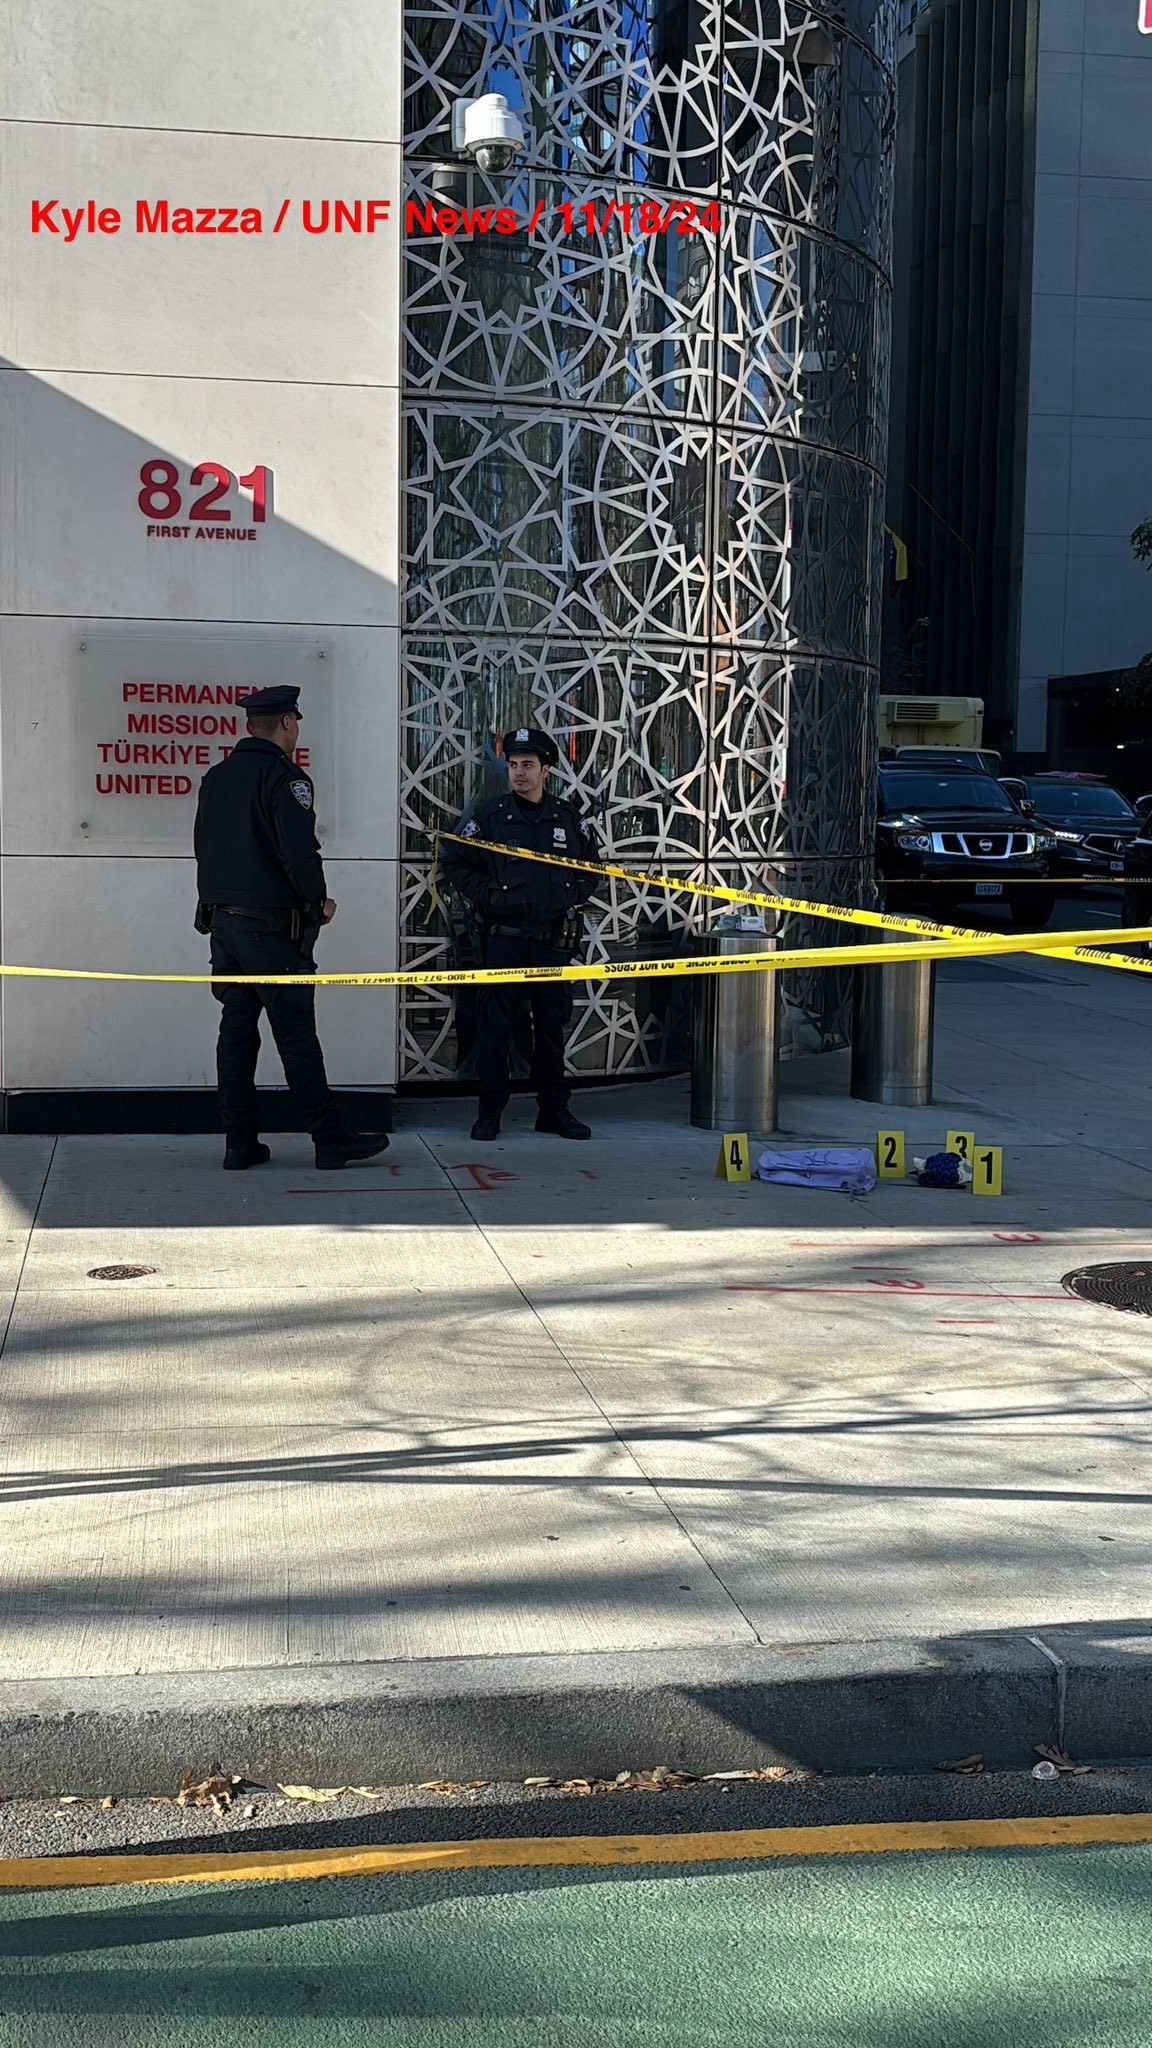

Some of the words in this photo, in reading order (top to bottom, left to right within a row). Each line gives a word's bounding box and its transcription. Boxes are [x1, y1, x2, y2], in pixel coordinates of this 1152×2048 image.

[138, 459, 274, 523] 821
[147, 525, 190, 538] FIRST
[195, 527, 257, 541] AVENUE
[128, 714, 237, 736] MISSION
[97, 739, 211, 765] TÜRKİYE
[95, 774, 193, 795] UNITED
[397, 973, 476, 983] 1-800-577-TIPS
[729, 1140, 743, 1172] 4
[884, 1136, 898, 1169] 2
[954, 1135, 968, 1158] 3
[980, 1151, 993, 1185] 1
